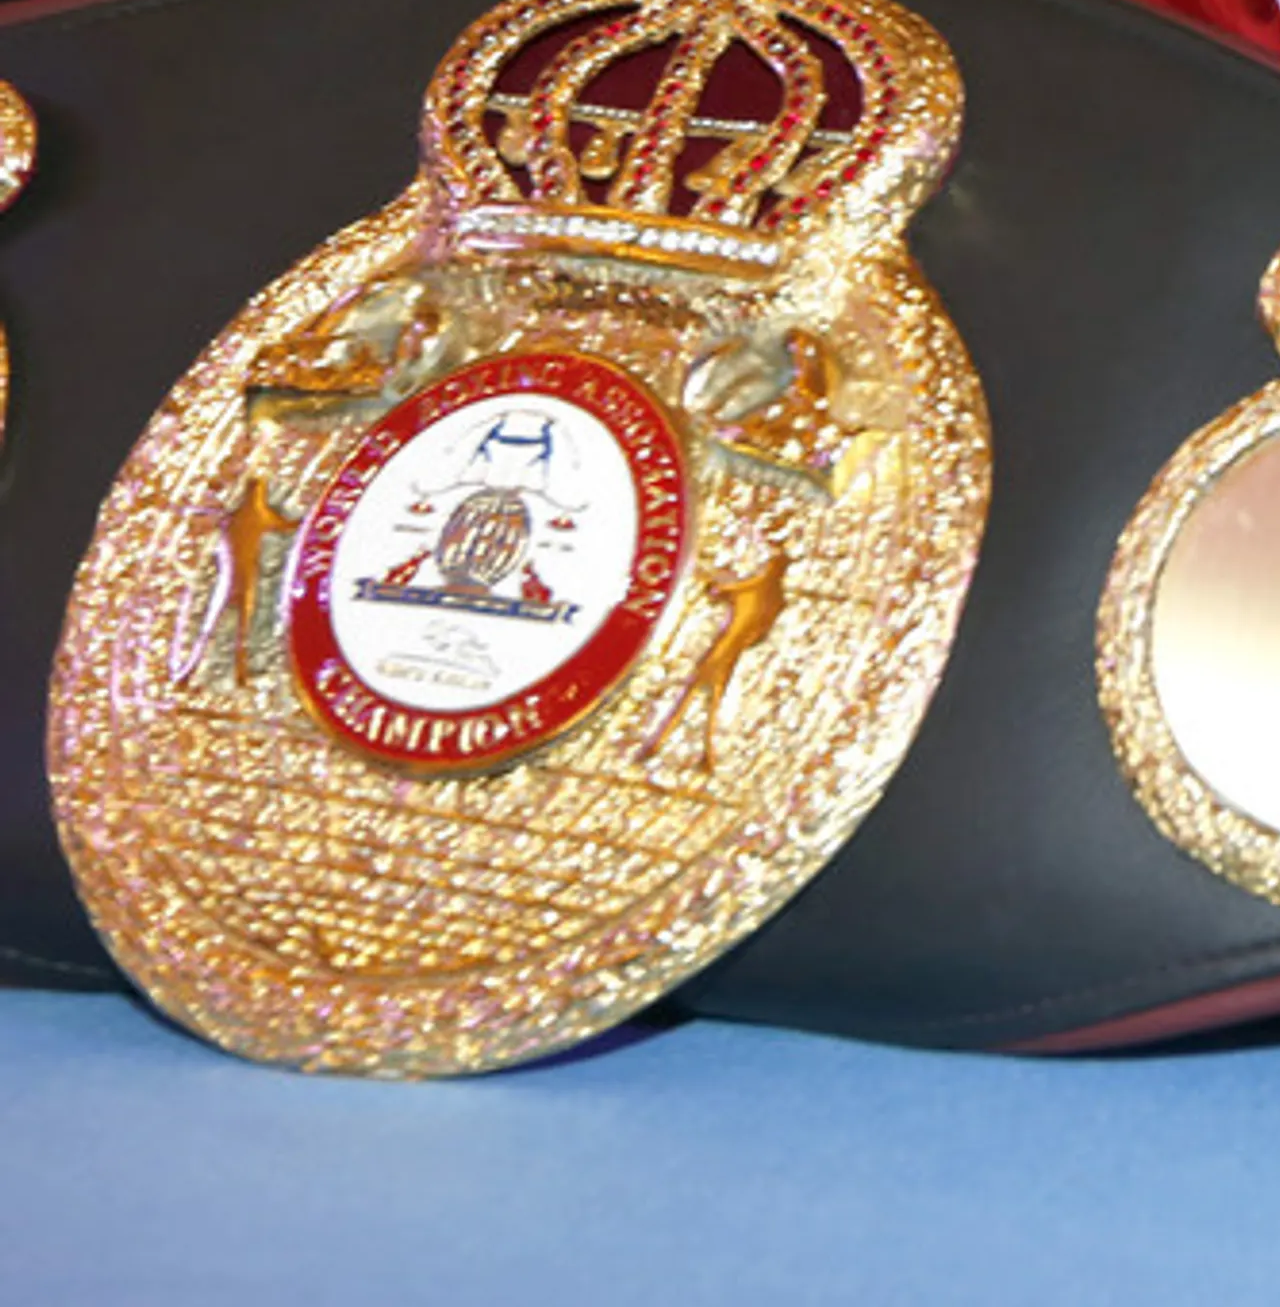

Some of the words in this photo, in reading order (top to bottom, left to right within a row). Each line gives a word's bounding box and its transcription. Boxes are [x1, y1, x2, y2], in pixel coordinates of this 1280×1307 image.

[302, 431, 400, 577] WORLD
[417, 361, 566, 430] BOXING
[576, 378, 680, 620] ASSOCIATION
[315, 658, 542, 753] CHAMPION
